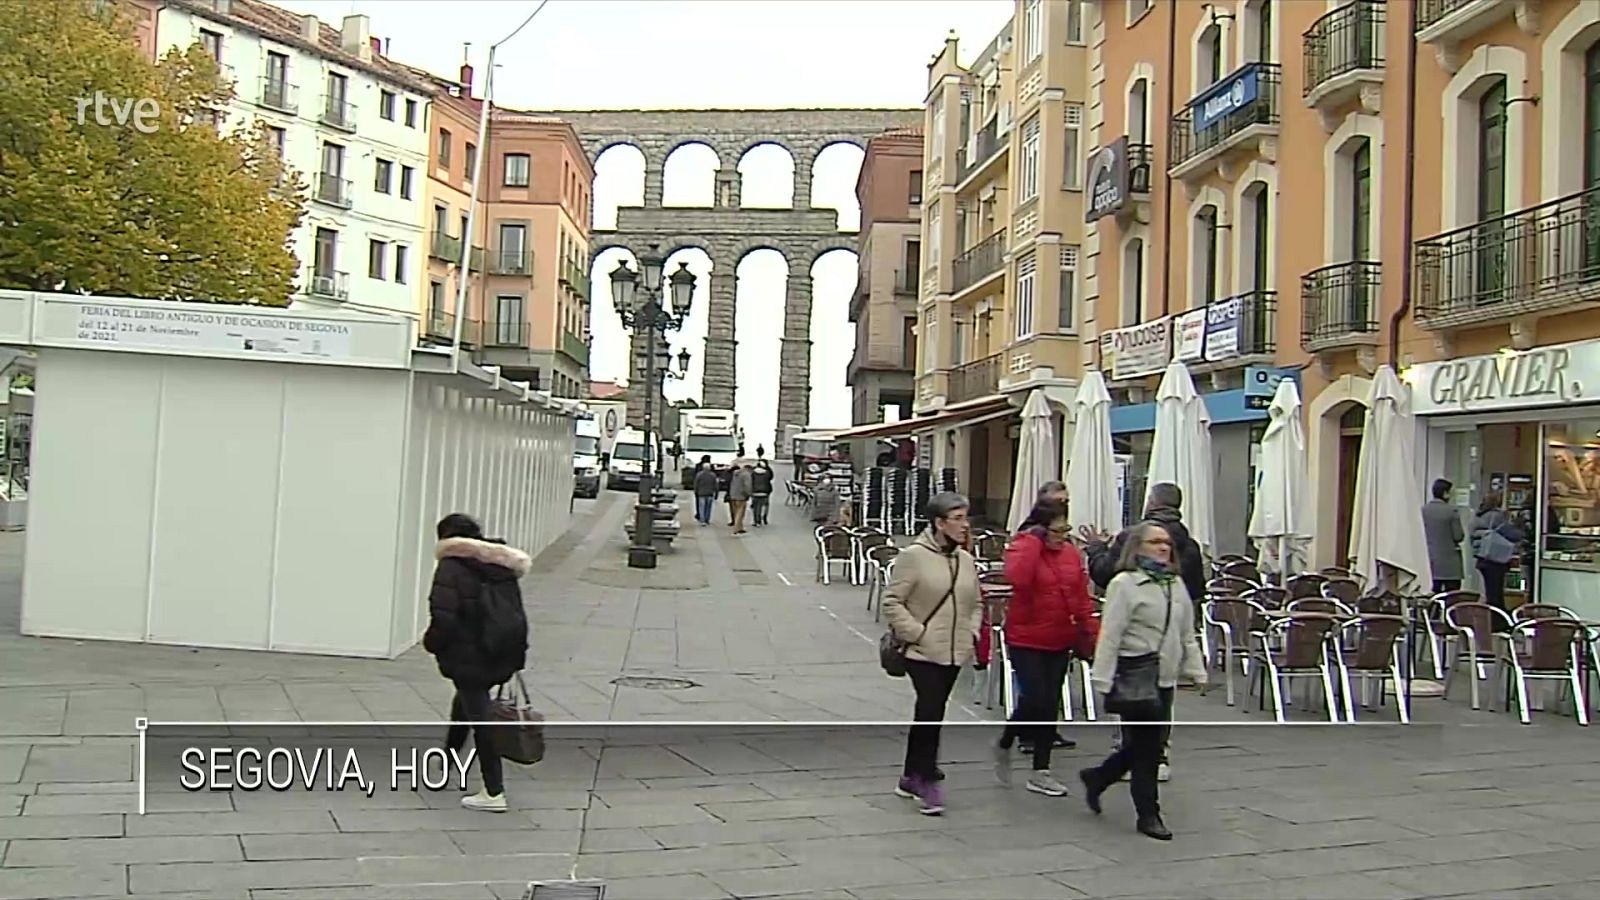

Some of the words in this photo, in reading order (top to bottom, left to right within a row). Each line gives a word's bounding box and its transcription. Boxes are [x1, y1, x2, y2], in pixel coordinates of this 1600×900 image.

[81, 305, 110, 316] FERIA
[112, 308, 131, 318] DEL
[134, 309, 165, 319] LIBRO
[167, 312, 214, 323] ANTIGUO
[216, 315, 222, 323] Y
[225, 316, 238, 325] DE
[288, 320, 302, 330] DE
[304, 322, 349, 334] SEGOVIA
[78, 331, 90, 339] de
[79, 320, 94, 328] del
[97, 321, 108, 329] 12
[110, 322, 119, 331] al
[121, 323, 133, 332] 21
[136, 325, 147, 333] de
[149, 325, 199, 336] Noviembre
